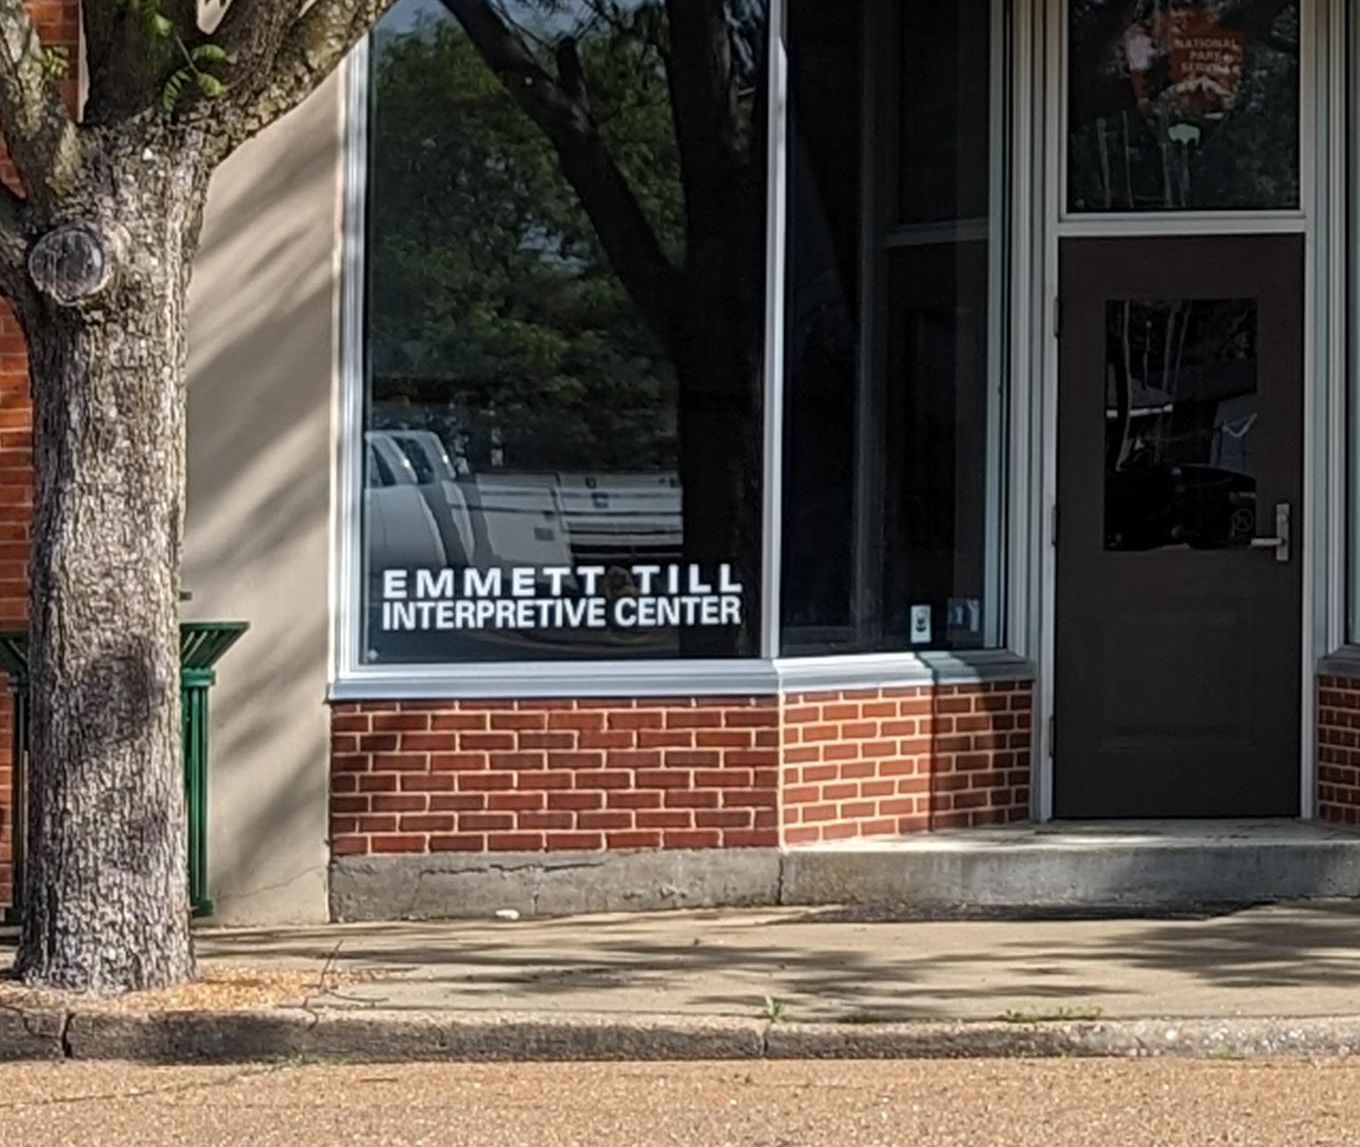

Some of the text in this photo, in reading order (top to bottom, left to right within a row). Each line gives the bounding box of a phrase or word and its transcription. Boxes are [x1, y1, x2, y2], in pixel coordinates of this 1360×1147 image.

[1174, 37, 1237, 49] NATIONAL
[383, 564, 742, 598] EMMETT TILL
[382, 596, 742, 630] INTERPRETIVE CENTER
